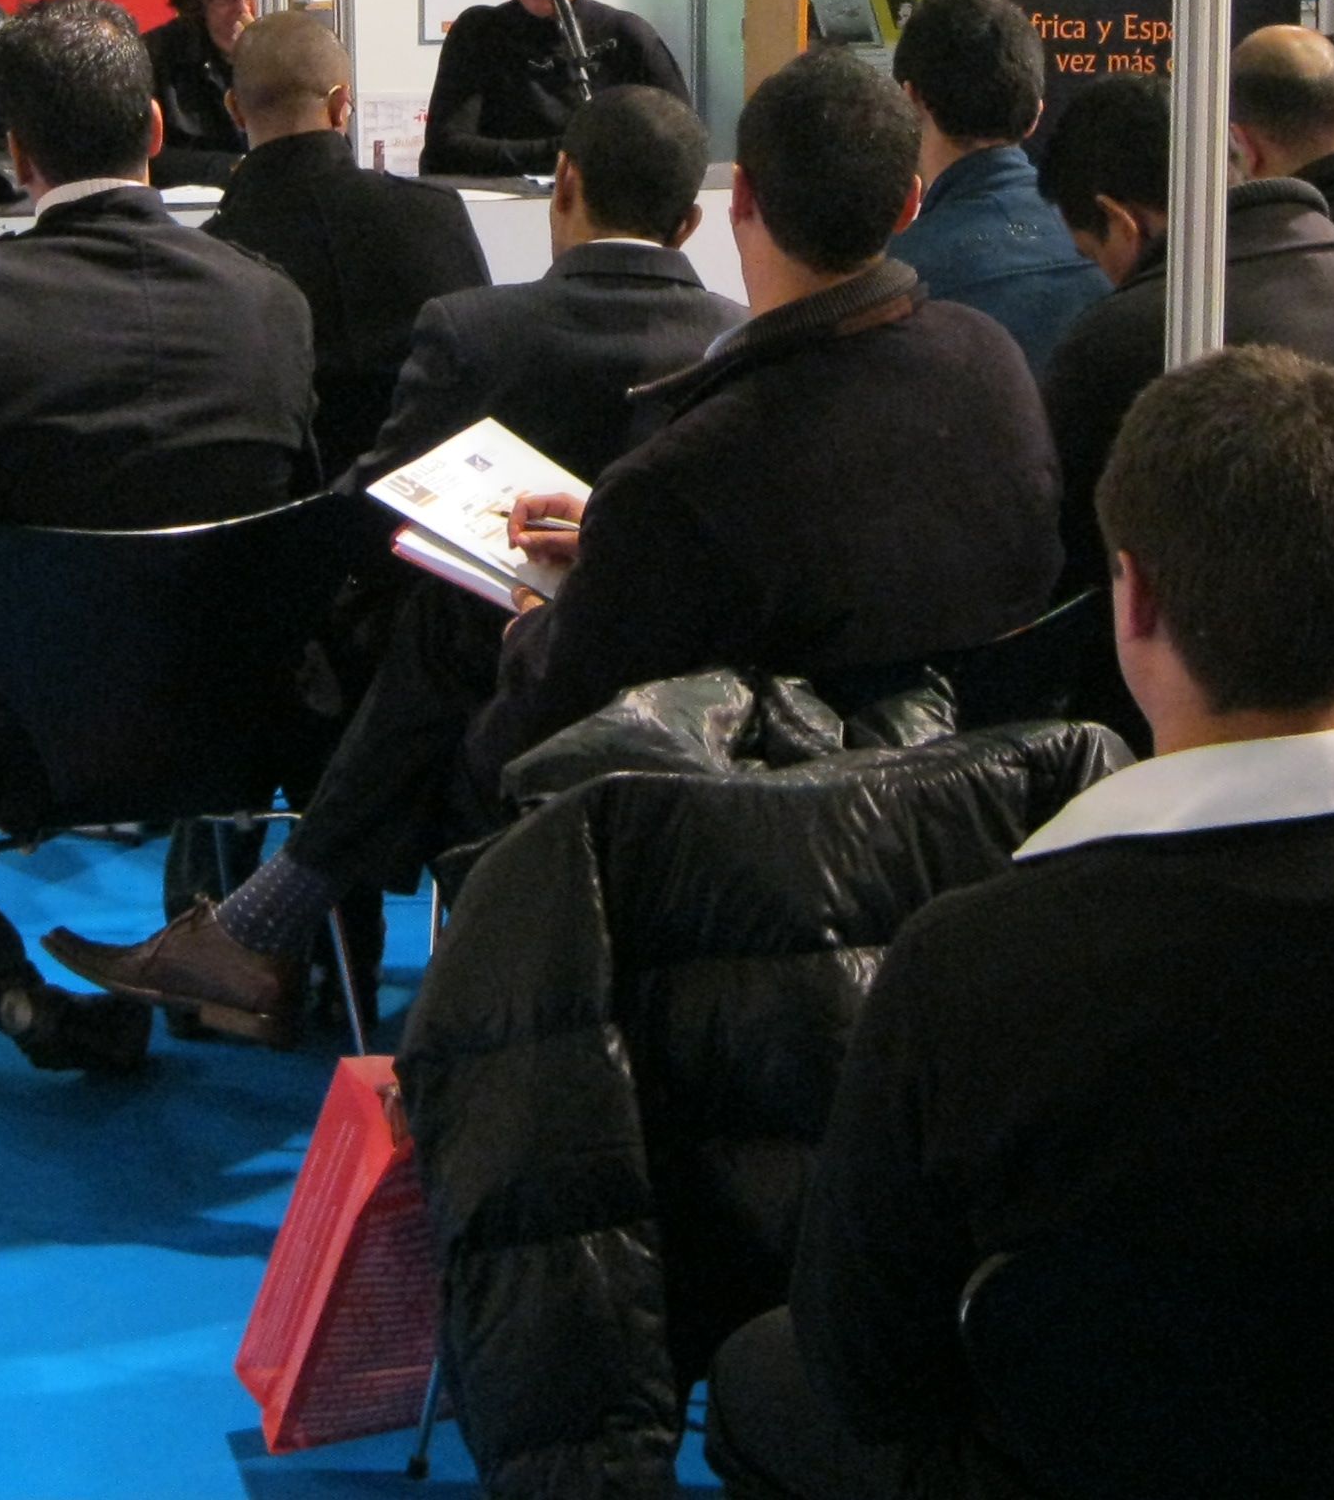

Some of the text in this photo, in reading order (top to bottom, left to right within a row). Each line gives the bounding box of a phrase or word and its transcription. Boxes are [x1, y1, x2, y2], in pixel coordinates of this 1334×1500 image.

[1030, 12, 1087, 41] frica
[1098, 20, 1114, 45] y
[1056, 49, 1156, 75] vez más
